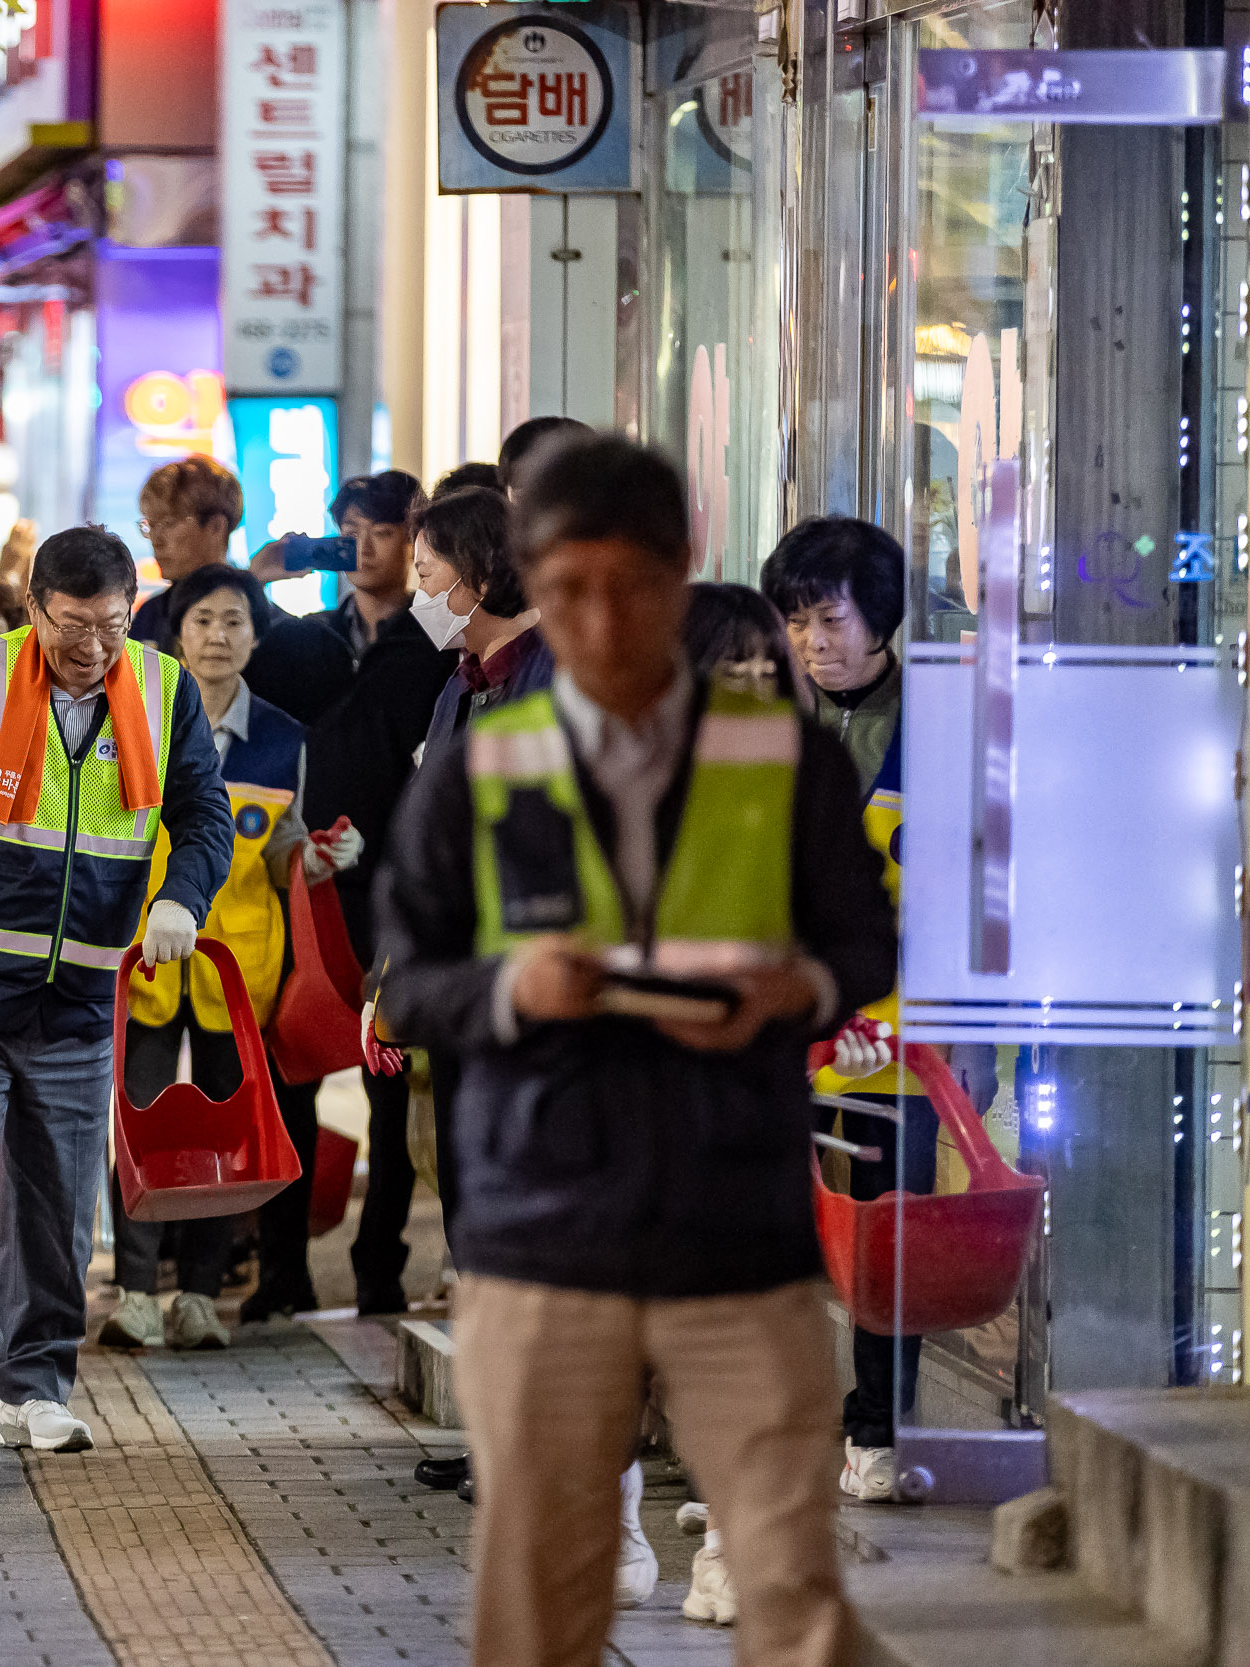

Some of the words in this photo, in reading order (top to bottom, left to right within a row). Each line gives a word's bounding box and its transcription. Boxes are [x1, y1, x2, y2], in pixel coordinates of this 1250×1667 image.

[480, 72, 588, 126] 담배
[488, 130, 578, 145] CIGARETTES
[248, 43, 322, 308] 센트럴치과
